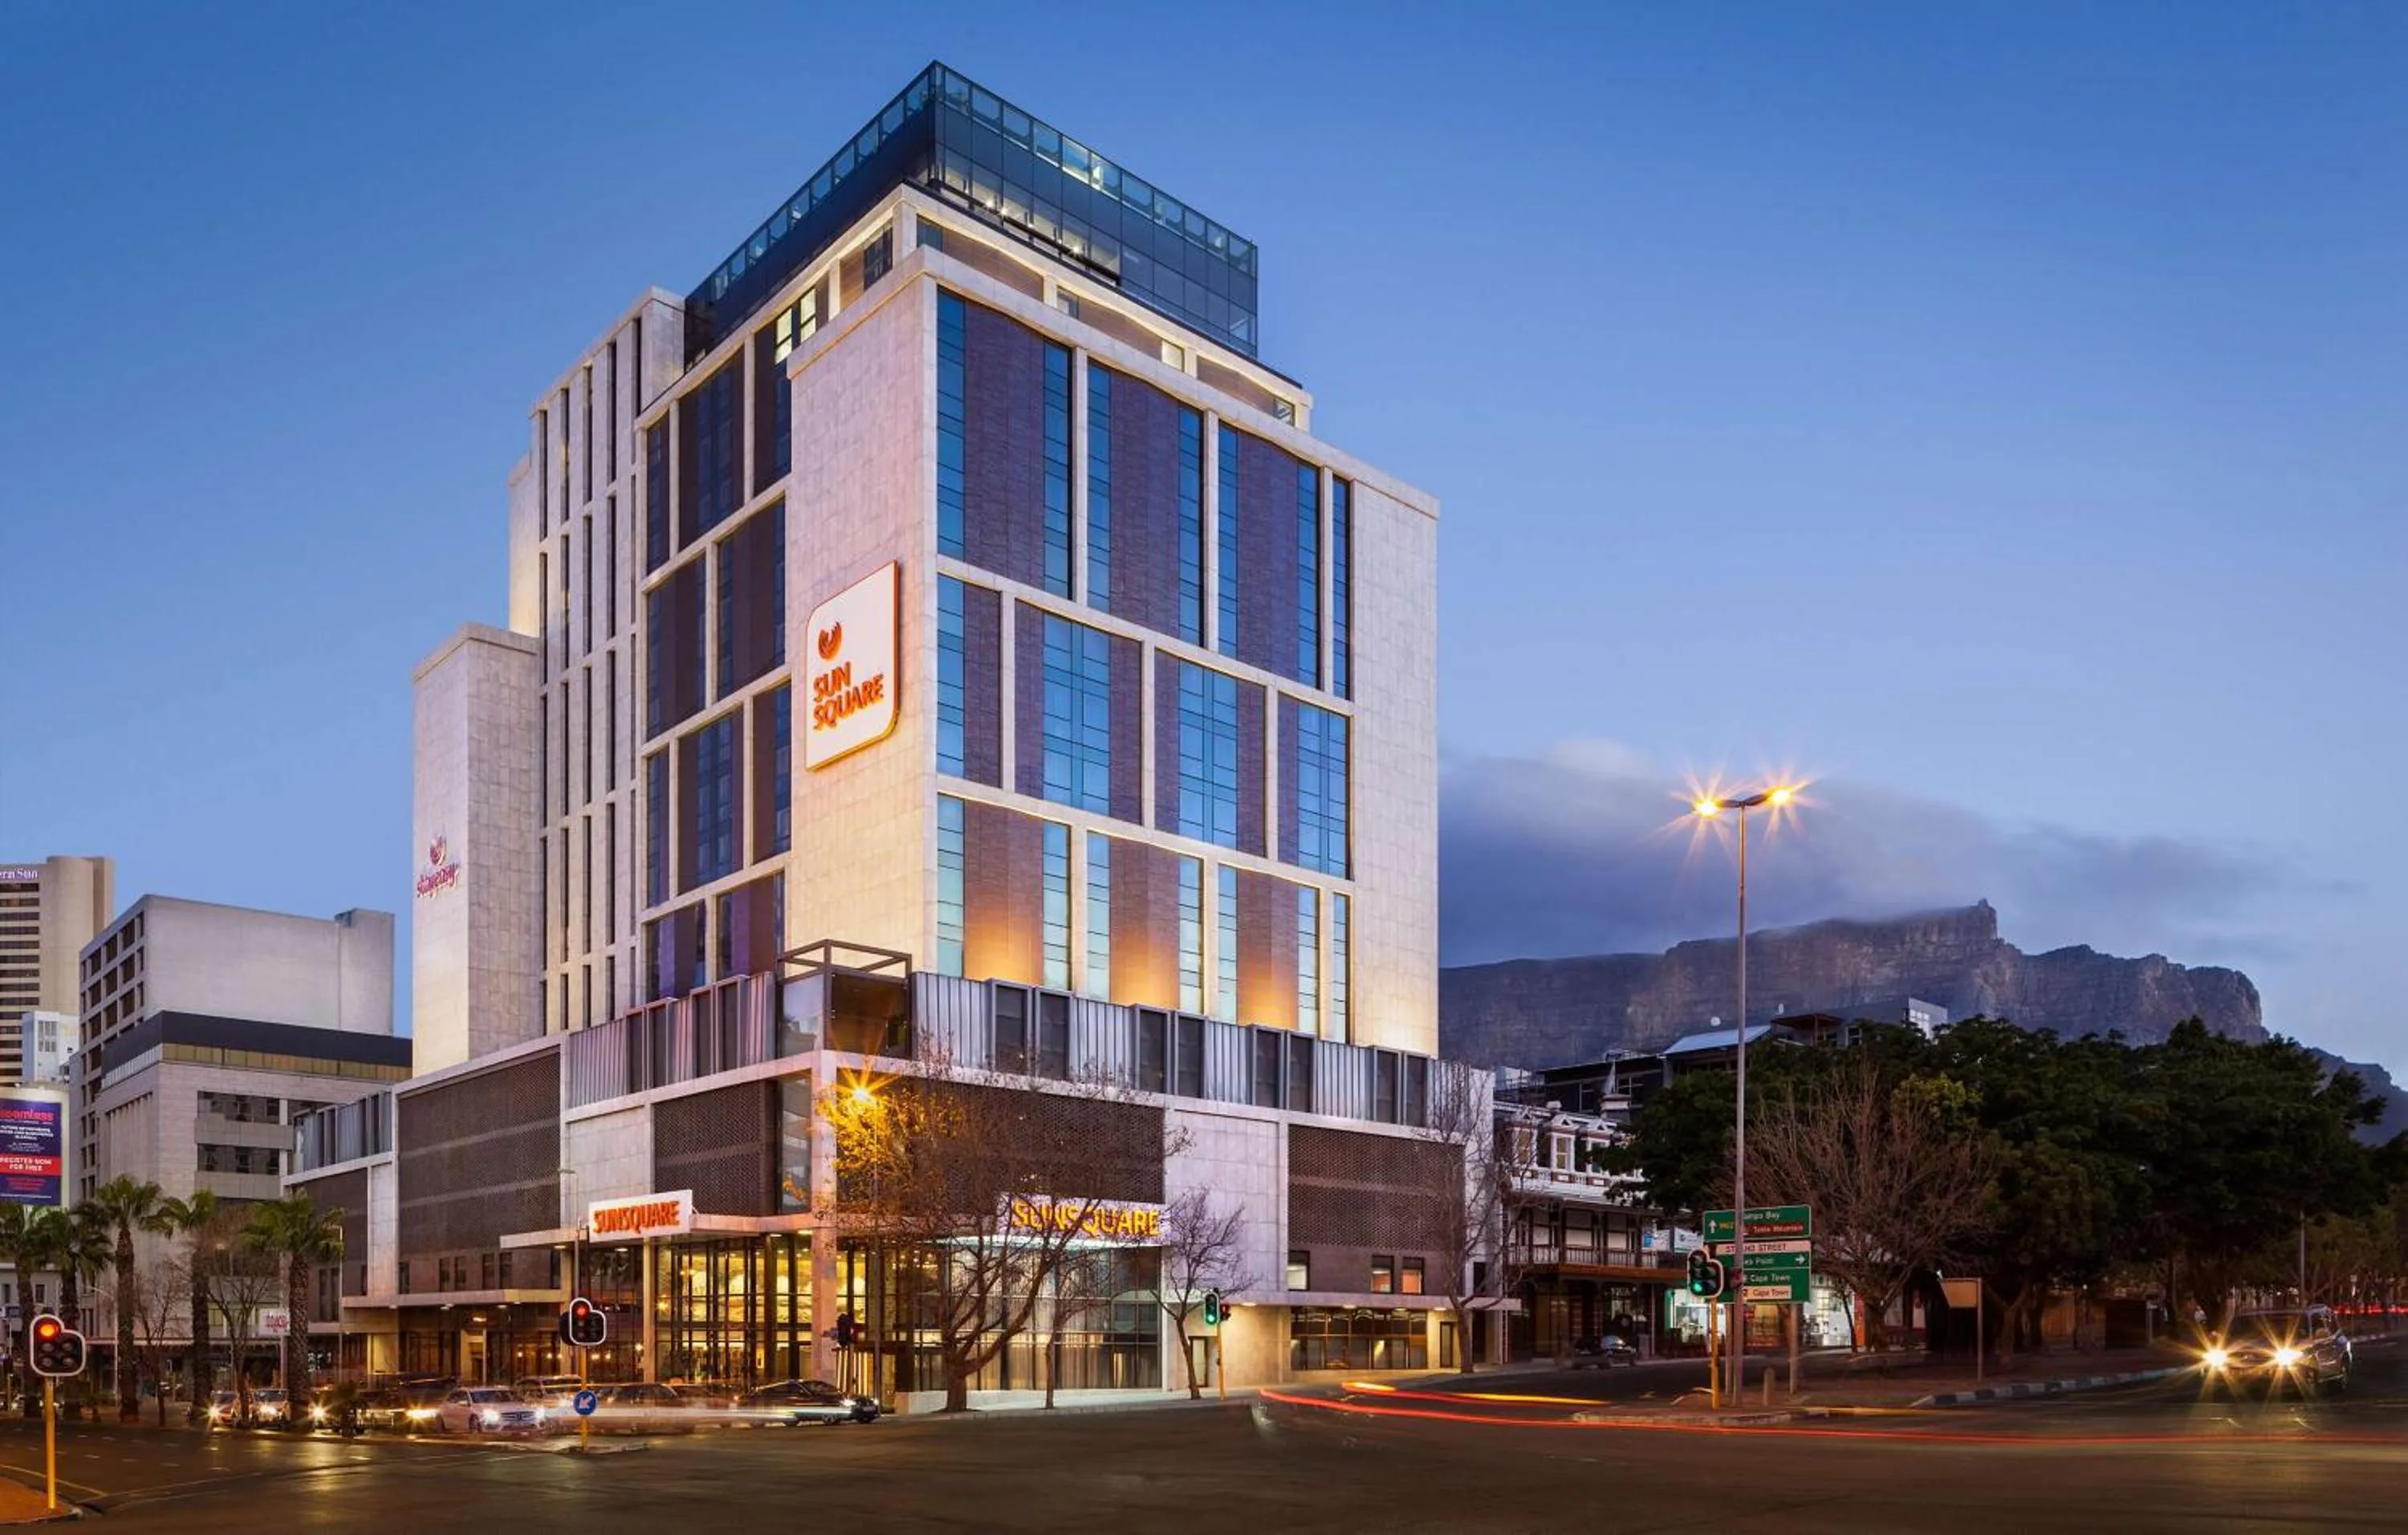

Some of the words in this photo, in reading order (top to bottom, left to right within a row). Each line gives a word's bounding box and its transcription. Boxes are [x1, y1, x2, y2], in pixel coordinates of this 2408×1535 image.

[814, 661, 851, 702] SUN
[814, 674, 884, 731] SQUARE
[594, 1200, 679, 1234] SUNSQUARE
[1013, 1199, 1161, 1238] SUNSQUARE
[1759, 1243, 1786, 1252] STREET
[1750, 1274, 1768, 1284] Cape
[1771, 1273, 1791, 1282] Town
[1752, 1289, 1770, 1297] Cape
